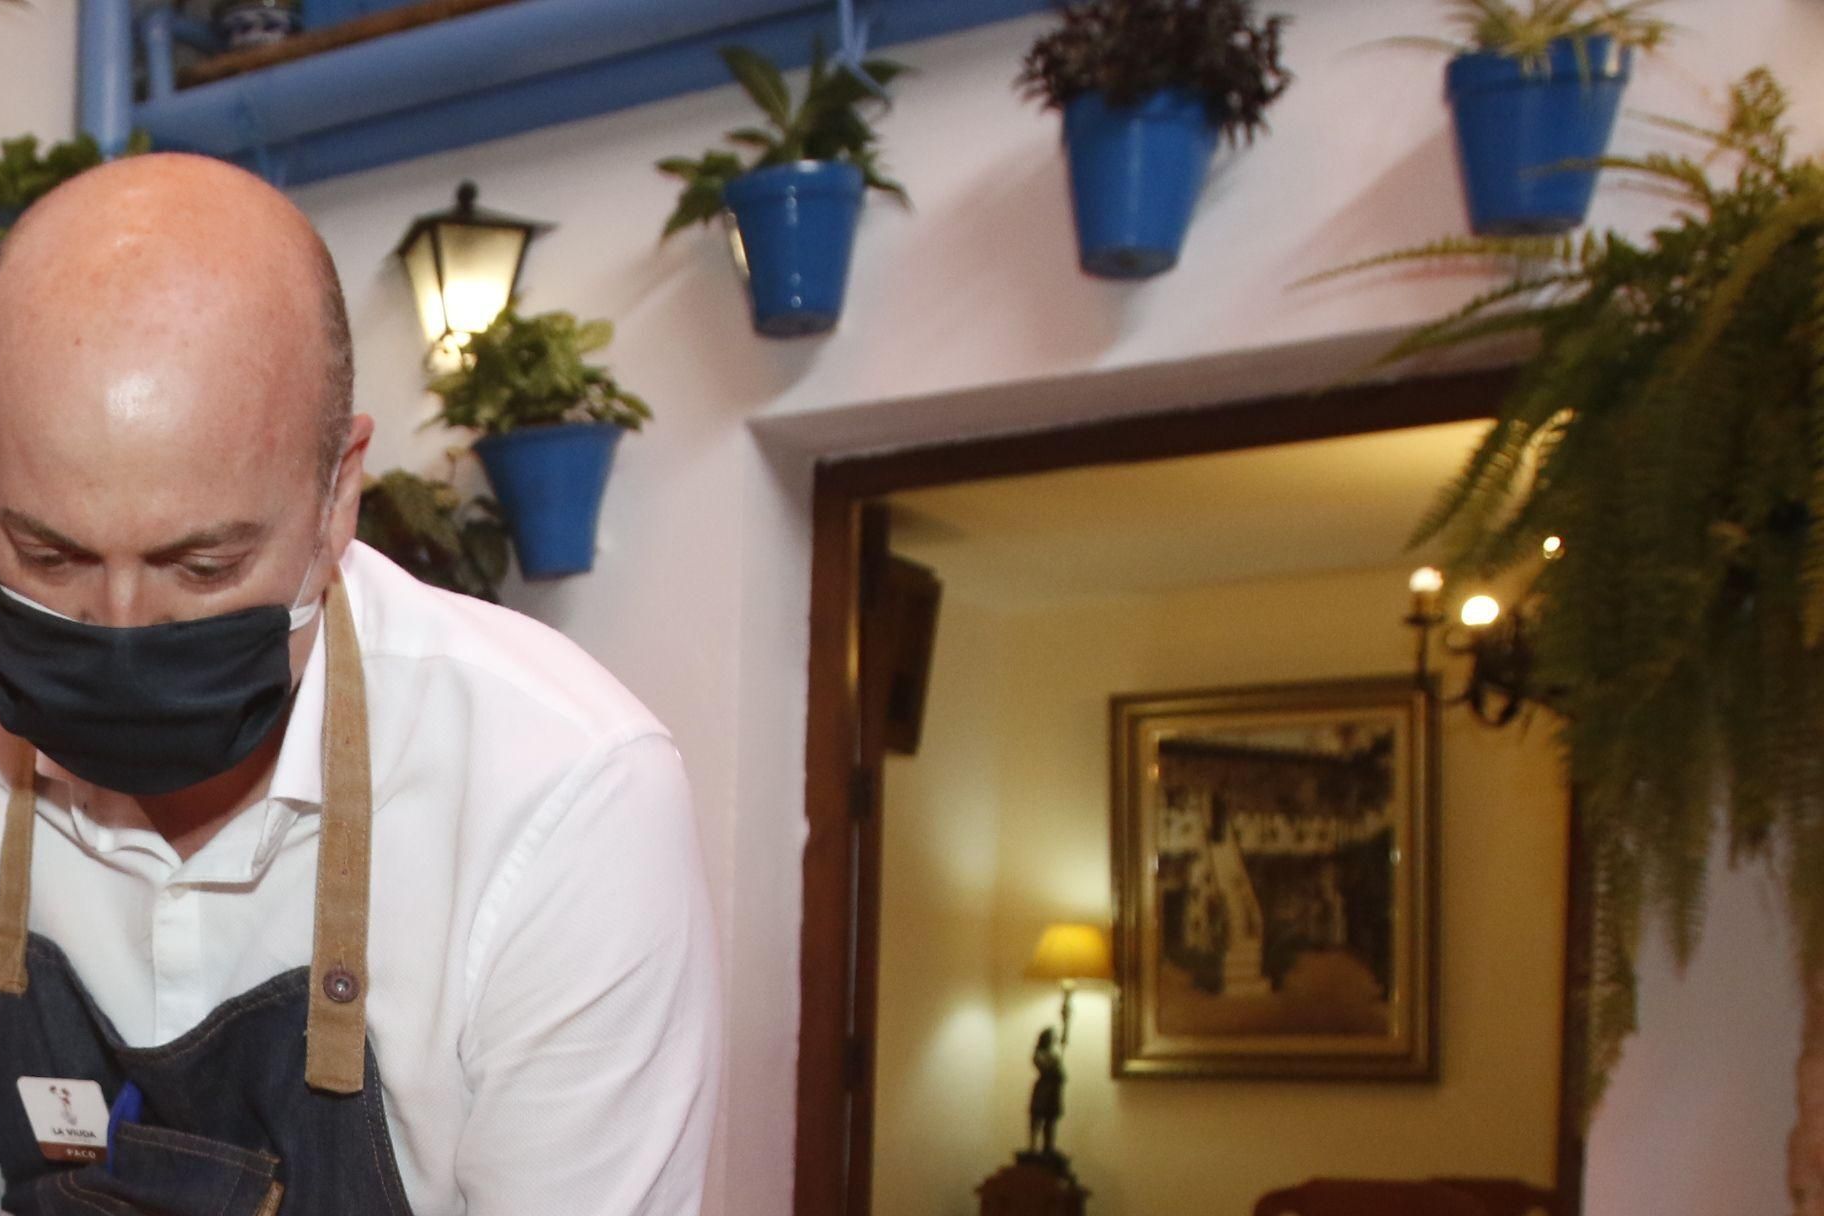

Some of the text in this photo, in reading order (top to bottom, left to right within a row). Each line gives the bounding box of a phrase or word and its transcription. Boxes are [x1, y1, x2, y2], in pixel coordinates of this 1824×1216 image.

[52, 1127, 97, 1138] LA VIUDA
[66, 1148, 96, 1159] PACO
